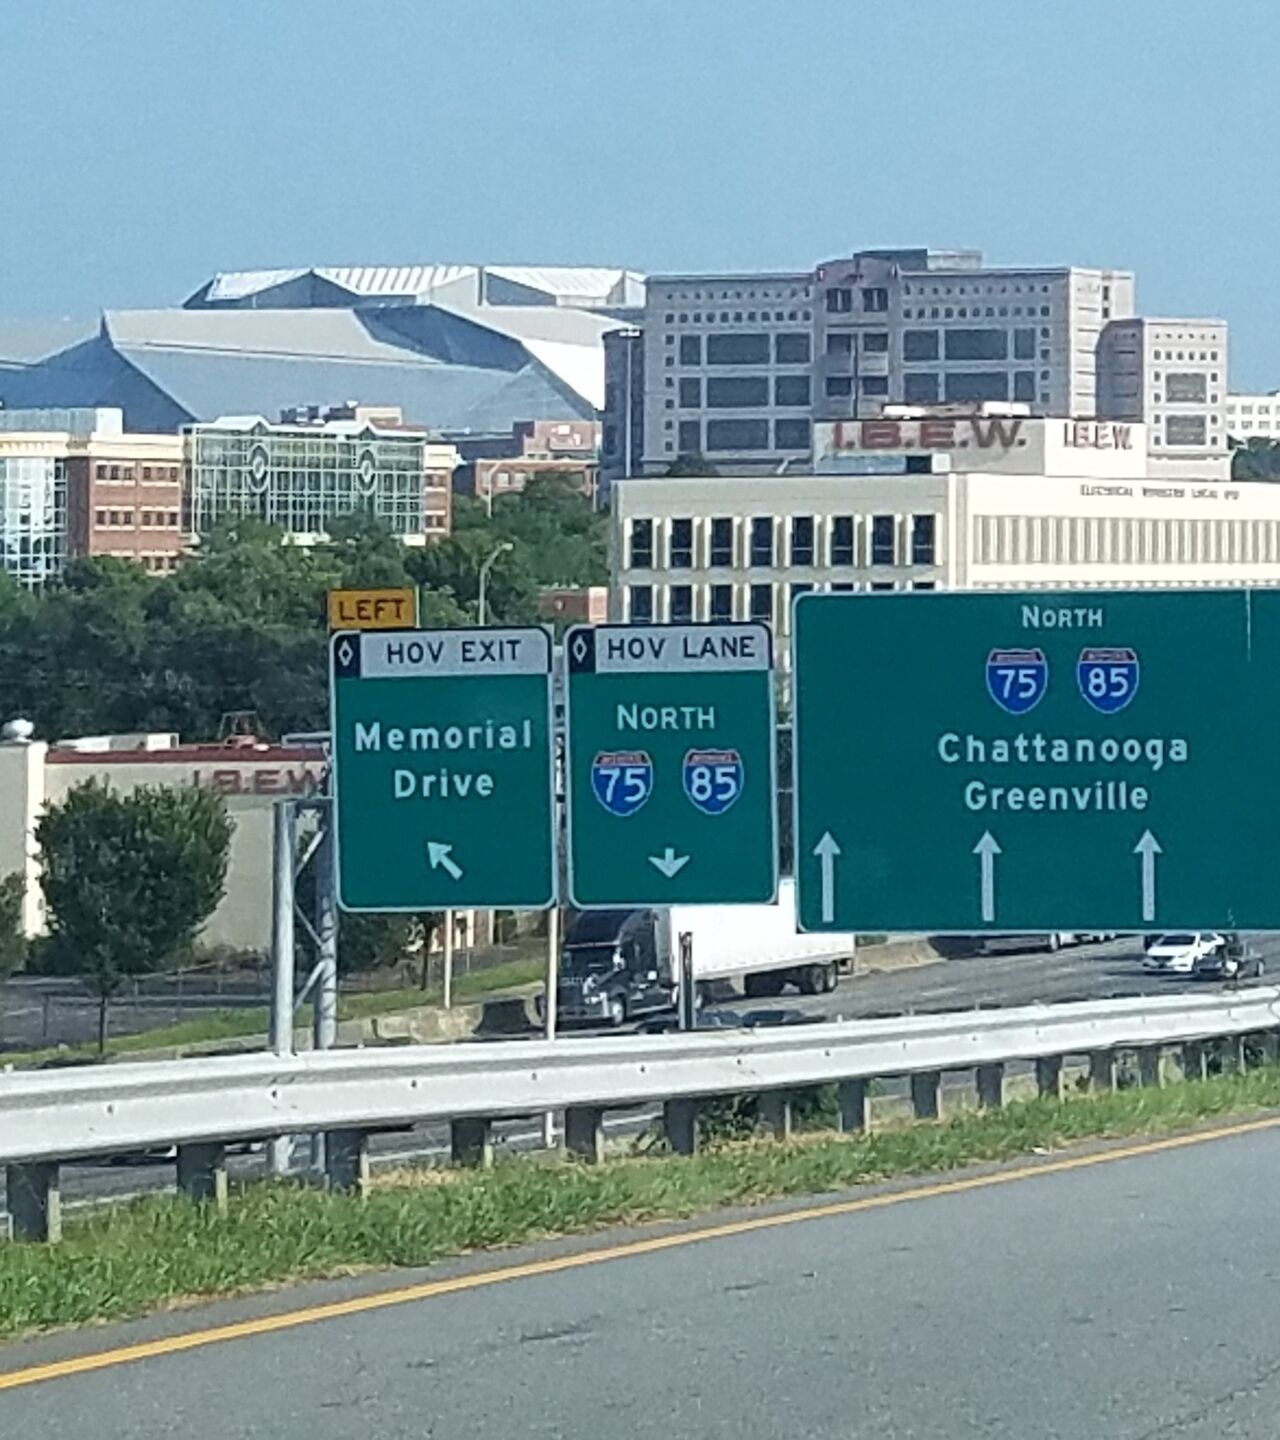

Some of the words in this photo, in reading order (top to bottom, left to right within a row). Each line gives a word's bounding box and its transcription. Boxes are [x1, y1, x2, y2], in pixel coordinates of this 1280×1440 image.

[337, 599, 405, 623] LEFT
[1021, 604, 1103, 628] NORTH
[387, 642, 443, 665] HOV
[462, 640, 522, 663] EXIT
[607, 638, 665, 660] HOV
[684, 636, 756, 659] LANE
[996, 669, 1037, 699] 75
[1088, 667, 1129, 698] 85
[616, 703, 716, 731] NORTH
[354, 719, 532, 751] Memorial
[937, 731, 1189, 771] Chattanooga
[394, 768, 494, 799] Drive
[599, 766, 647, 803] 75
[691, 765, 738, 802] 85
[964, 780, 1149, 811] Greenville
